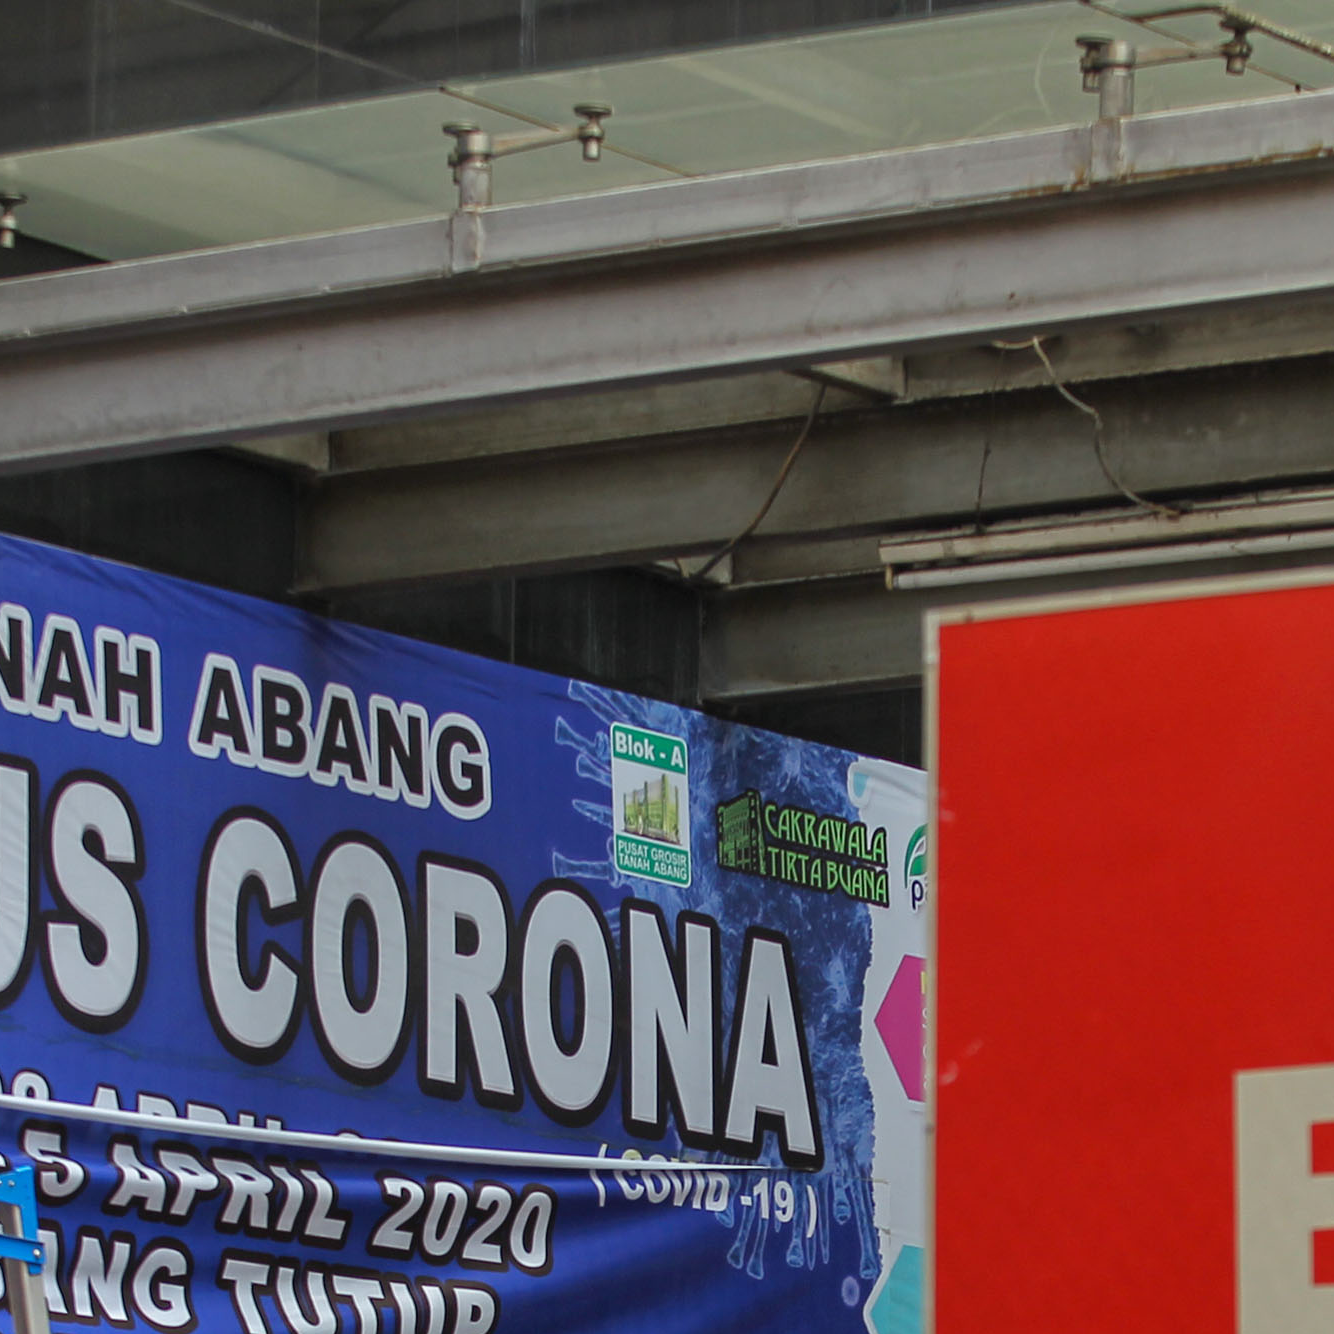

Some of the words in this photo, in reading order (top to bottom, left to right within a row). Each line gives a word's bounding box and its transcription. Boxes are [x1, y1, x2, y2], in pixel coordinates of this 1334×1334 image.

[189, 652, 492, 819] ABANG
[614, 730, 656, 762] Blok
[670, 745, 684, 769] A
[617, 839, 649, 859] PUSAT
[650, 848, 687, 868] GROSIR
[765, 804, 885, 864] CAKRAWALA
[618, 852, 650, 872] TANAH
[653, 861, 687, 881] ABANG
[766, 845, 822, 889] TIRTA
[825, 860, 888, 904] BUANA
[201, 814, 820, 1158] CORONA
[23, 1127, 85, 1197] 5
[107, 1141, 349, 1242] APRIL
[371, 1175, 553, 1271] 2020
